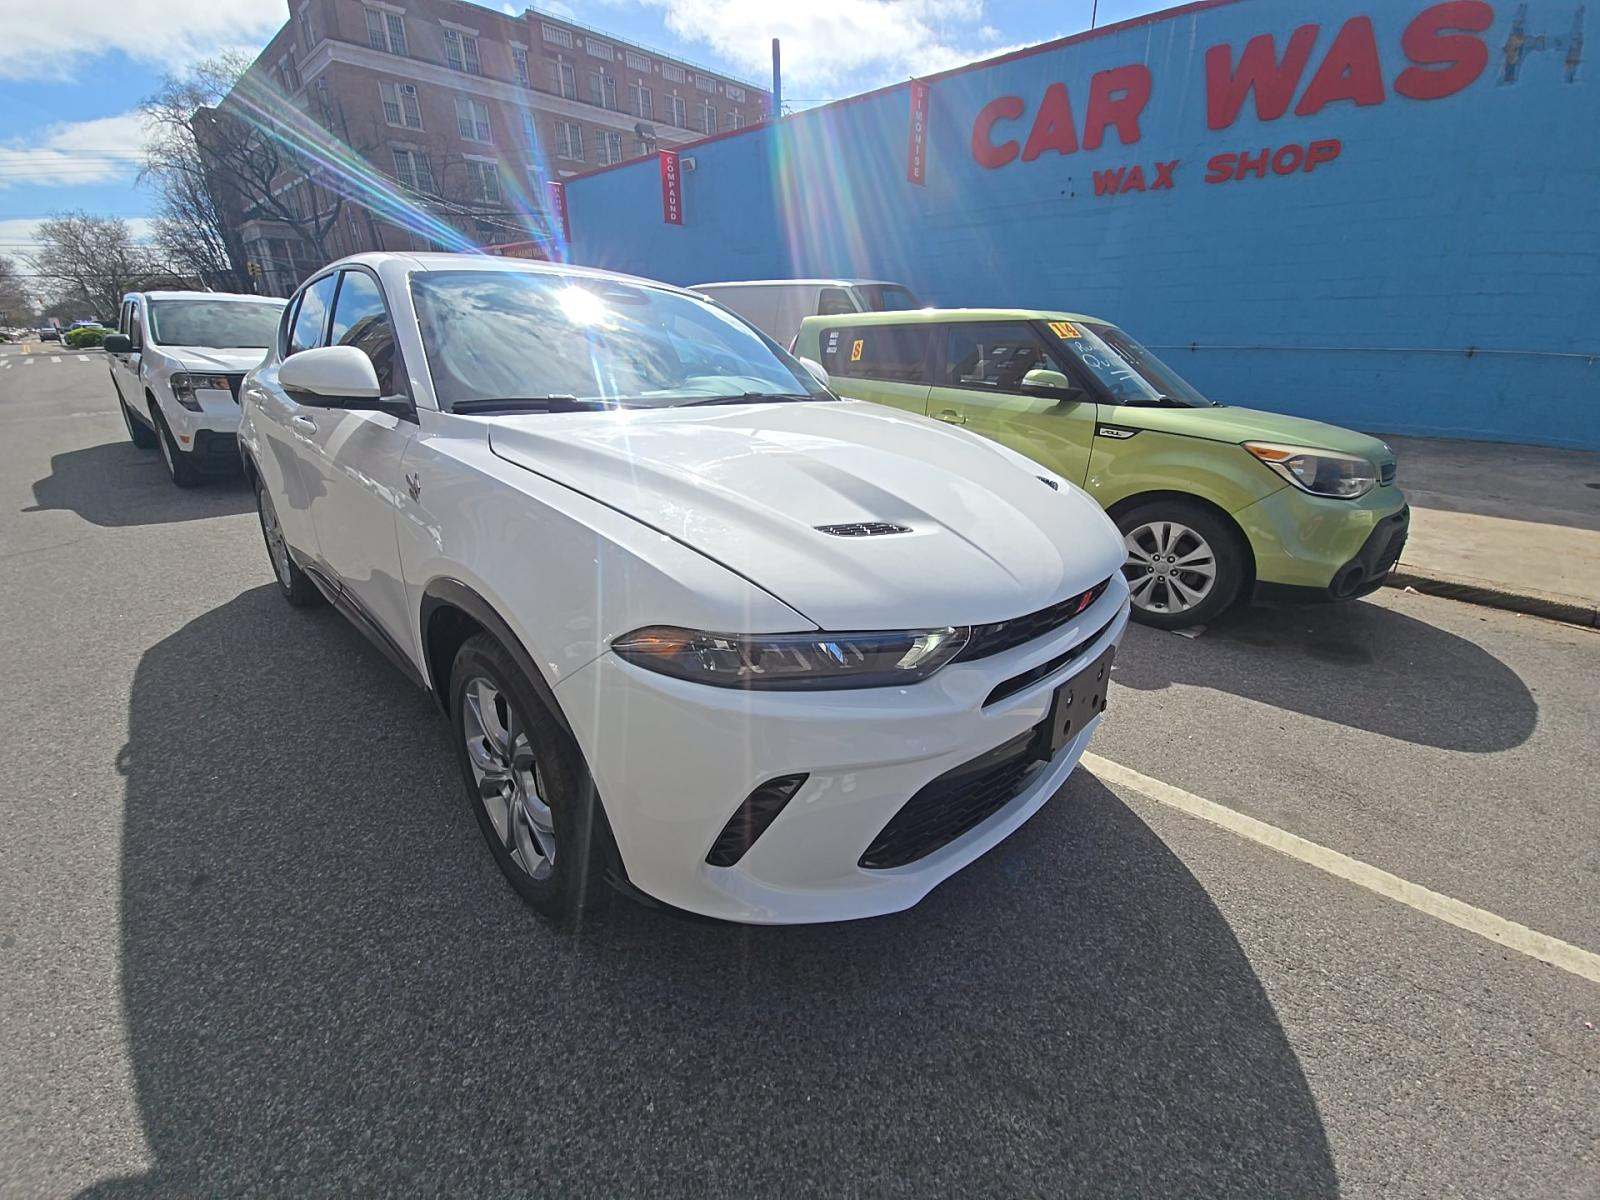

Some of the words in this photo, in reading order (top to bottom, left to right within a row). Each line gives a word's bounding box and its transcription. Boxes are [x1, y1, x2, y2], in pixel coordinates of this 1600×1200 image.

[972, 64, 1152, 169] CAR
[1092, 160, 1179, 196] WAX
[1204, 139, 1342, 184] SHOP
